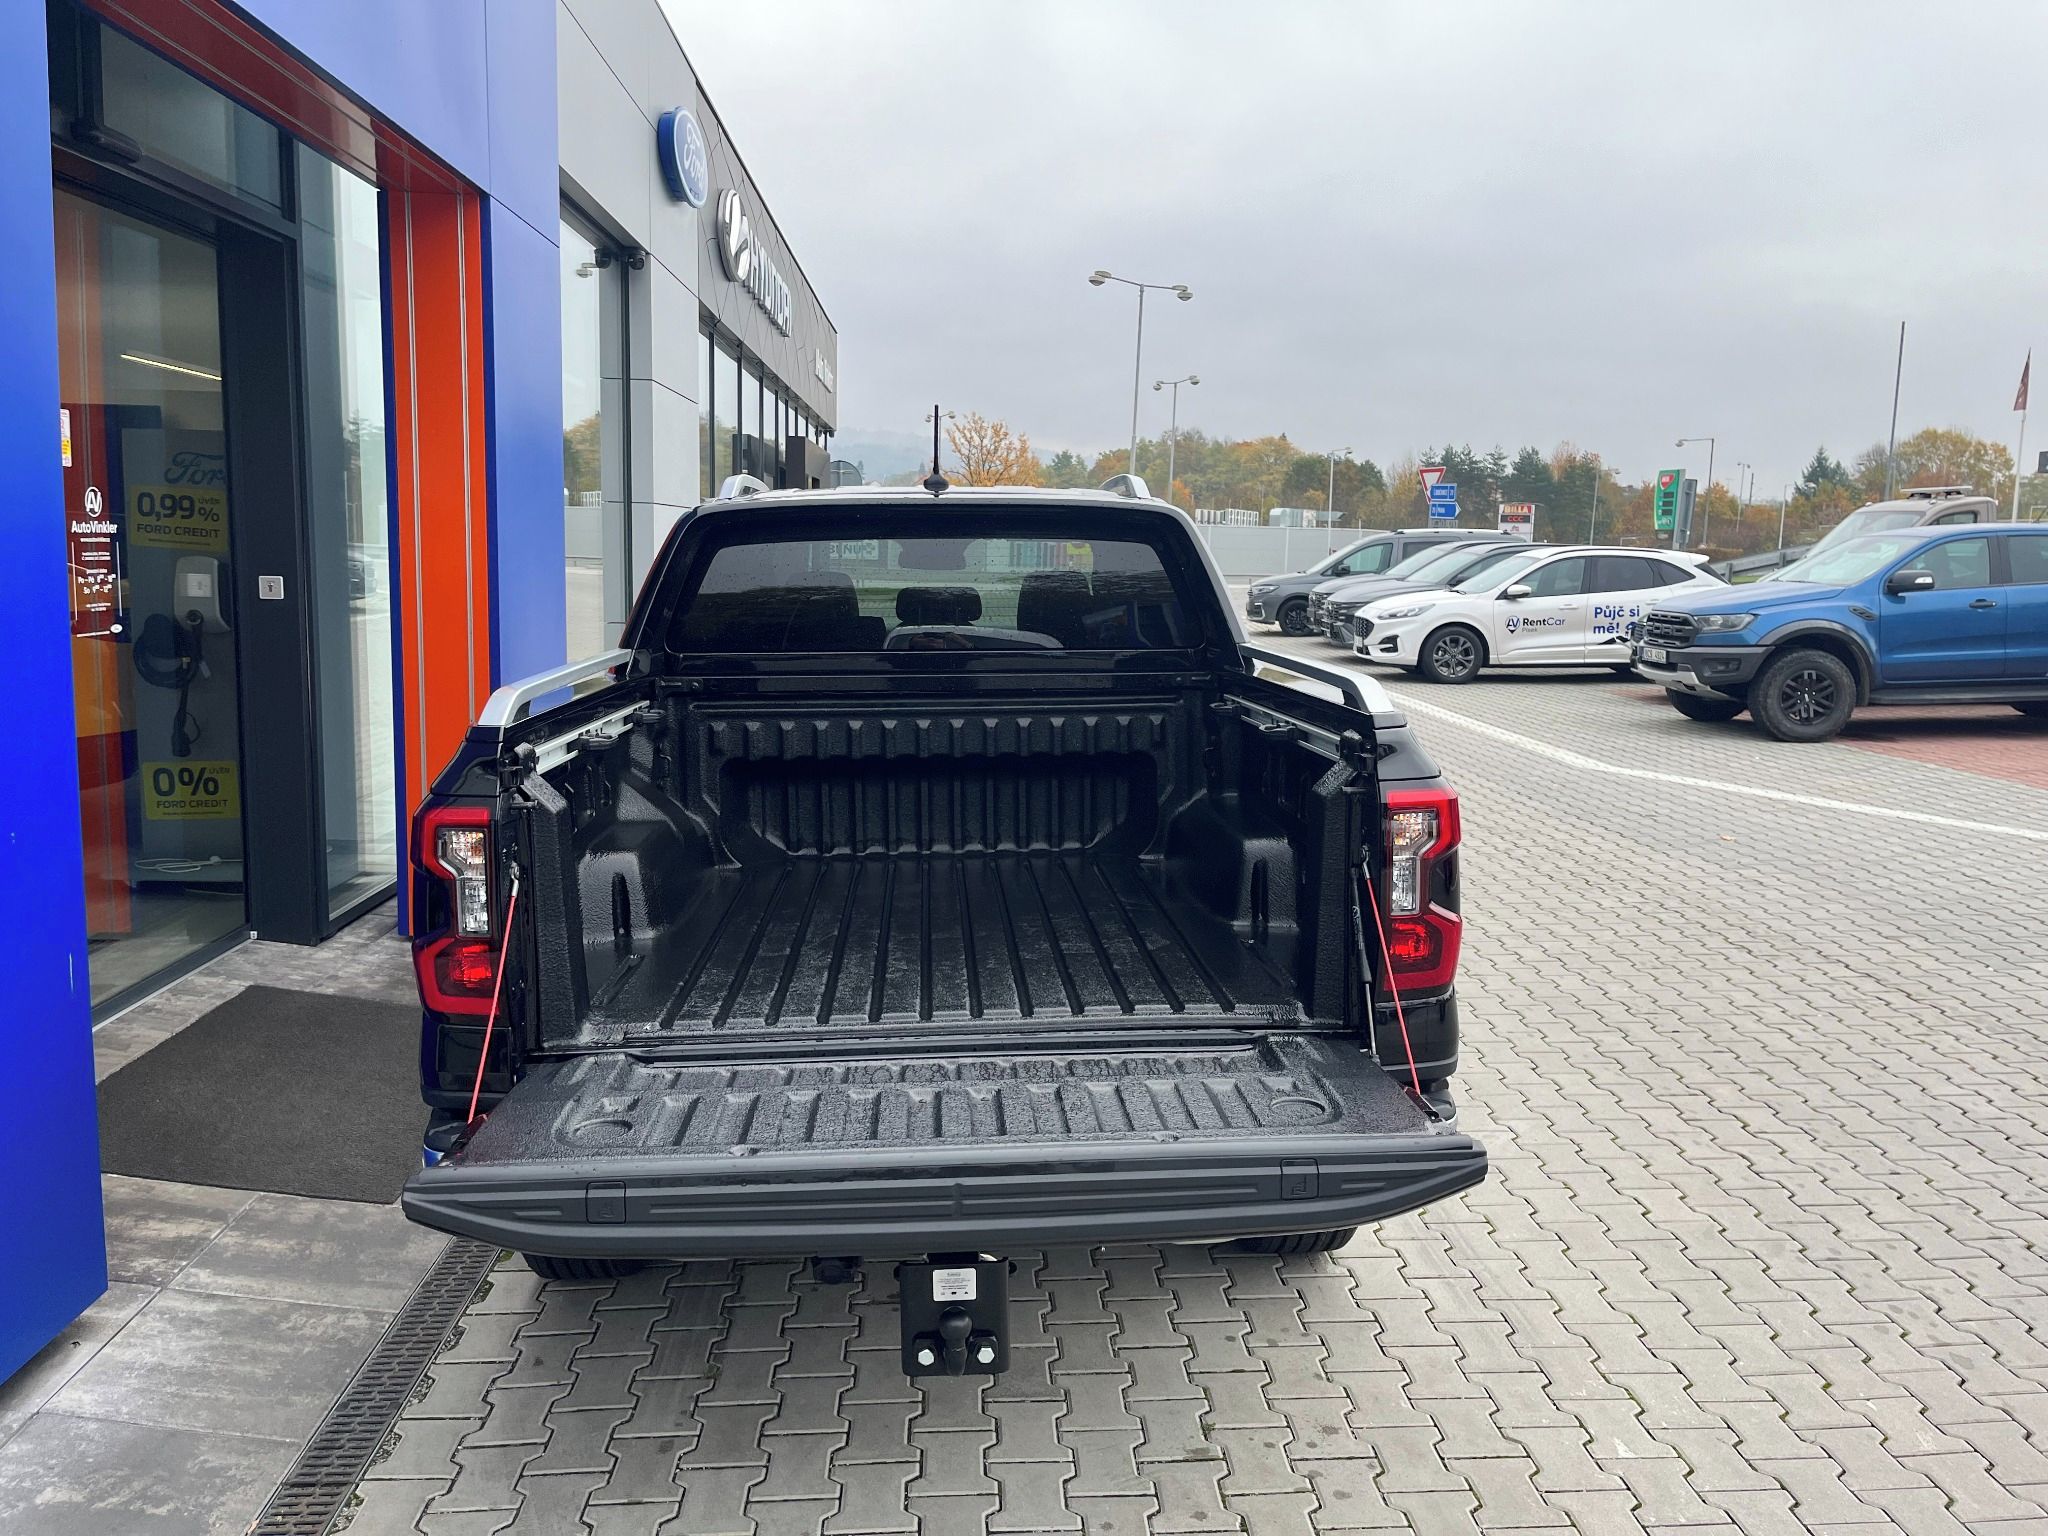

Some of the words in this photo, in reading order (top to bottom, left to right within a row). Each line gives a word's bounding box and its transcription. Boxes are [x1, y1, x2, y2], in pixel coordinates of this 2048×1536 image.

[164, 451, 226, 485] For
[1504, 505, 1529, 513] BILLA
[71, 520, 118, 534] AutoVinkler
[137, 523, 172, 535] FORD
[174, 526, 221, 538] CREDIT
[1594, 605, 1625, 621] Půjč
[1629, 605, 1640, 617] si
[1522, 617, 1566, 626] RentCar
[1593, 621, 1620, 634] mě!
[152, 767, 219, 796] 0%
[156, 800, 186, 809] FORD
[188, 799, 229, 808] CREDIT
